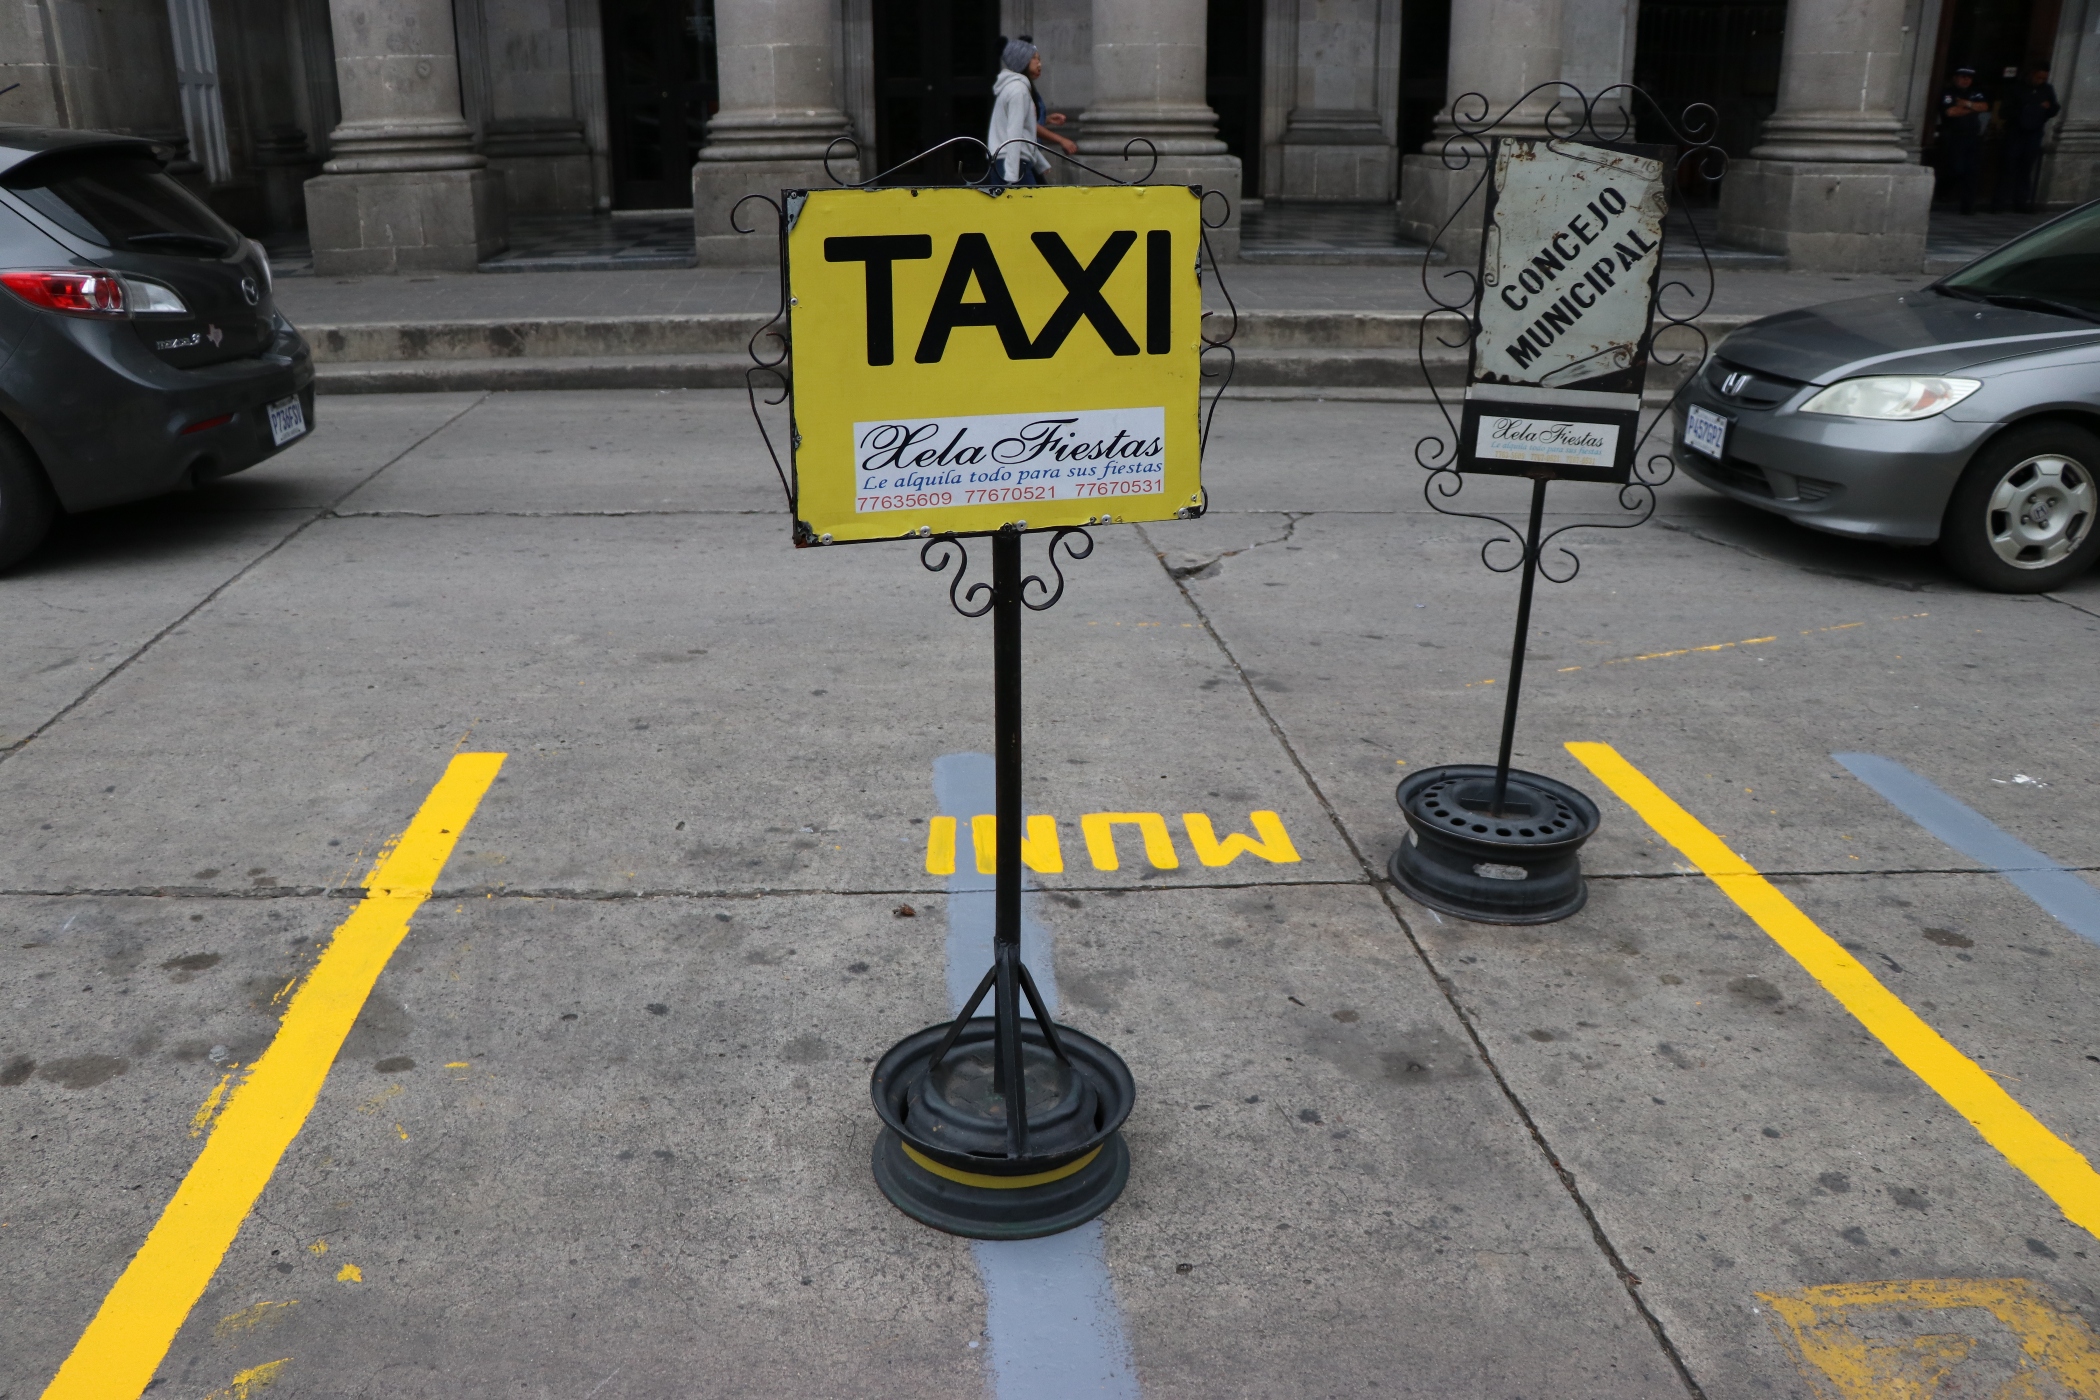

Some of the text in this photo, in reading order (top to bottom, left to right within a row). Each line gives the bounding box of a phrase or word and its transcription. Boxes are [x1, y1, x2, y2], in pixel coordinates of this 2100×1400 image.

[1501, 187, 1627, 311] CONCEJO
[823, 229, 1172, 367] TAXI
[1505, 229, 1658, 370] MUNICIPAL
[860, 417, 1164, 471] Xela Fiestas
[1492, 417, 1605, 447] Xela Fiestas
[1687, 415, 1723, 448] P457GPZ
[857, 479, 1162, 511] 77635609 77670521 77670531
[862, 460, 1163, 491] Le alquila todo para sus fiestas
[926, 810, 1302, 875] MUNI
